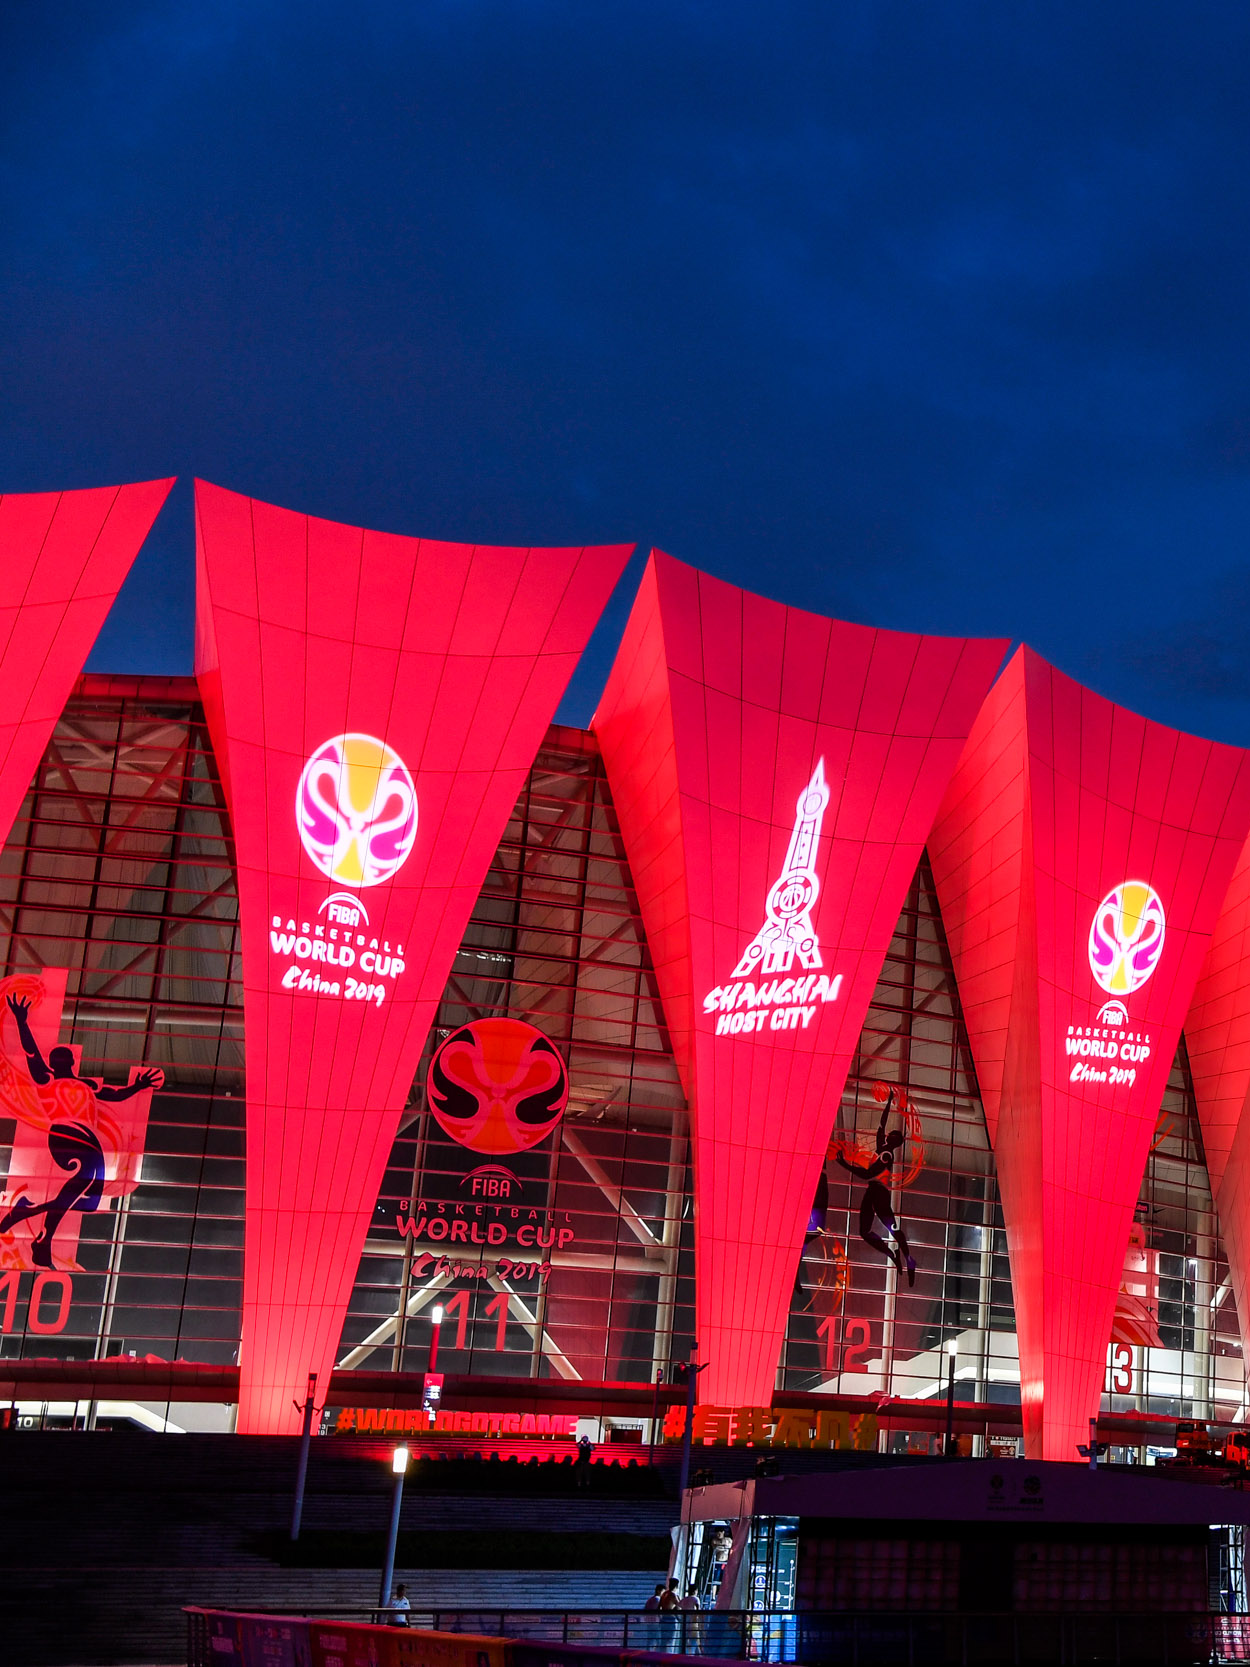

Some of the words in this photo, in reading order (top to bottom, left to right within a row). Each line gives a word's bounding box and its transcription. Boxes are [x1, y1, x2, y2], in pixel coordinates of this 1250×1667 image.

[328, 903, 360, 927] FIBA
[272, 916, 404, 956] BASKETBALL
[270, 931, 355, 968] WORLD
[359, 951, 405, 979] CUP
[281, 965, 340, 996] China
[343, 977, 386, 1008] 2019
[703, 974, 843, 1014] SHANGHAI
[715, 1009, 769, 1036] HOST
[770, 1005, 817, 1031] CITY
[1102, 1009, 1124, 1026] FIBA
[1065, 1037, 1119, 1059] WORLD
[1120, 1043, 1151, 1063] CUP
[1067, 1025, 1150, 1043] BASKETBALL
[1069, 1061, 1107, 1083] China
[1108, 1065, 1136, 1088] 2019
[471, 1178, 511, 1198] FIBA
[400, 1200, 572, 1223] BASKETBALL
[396, 1215, 508, 1245] WORLD
[516, 1224, 575, 1249] CUP
[410, 1252, 489, 1279] China
[498, 1258, 553, 1286] 2019
[0, 1270, 73, 1334] 10
[445, 1290, 510, 1351] 11
[816, 1315, 871, 1373] 12
[17, 1417, 34, 1428] 10
